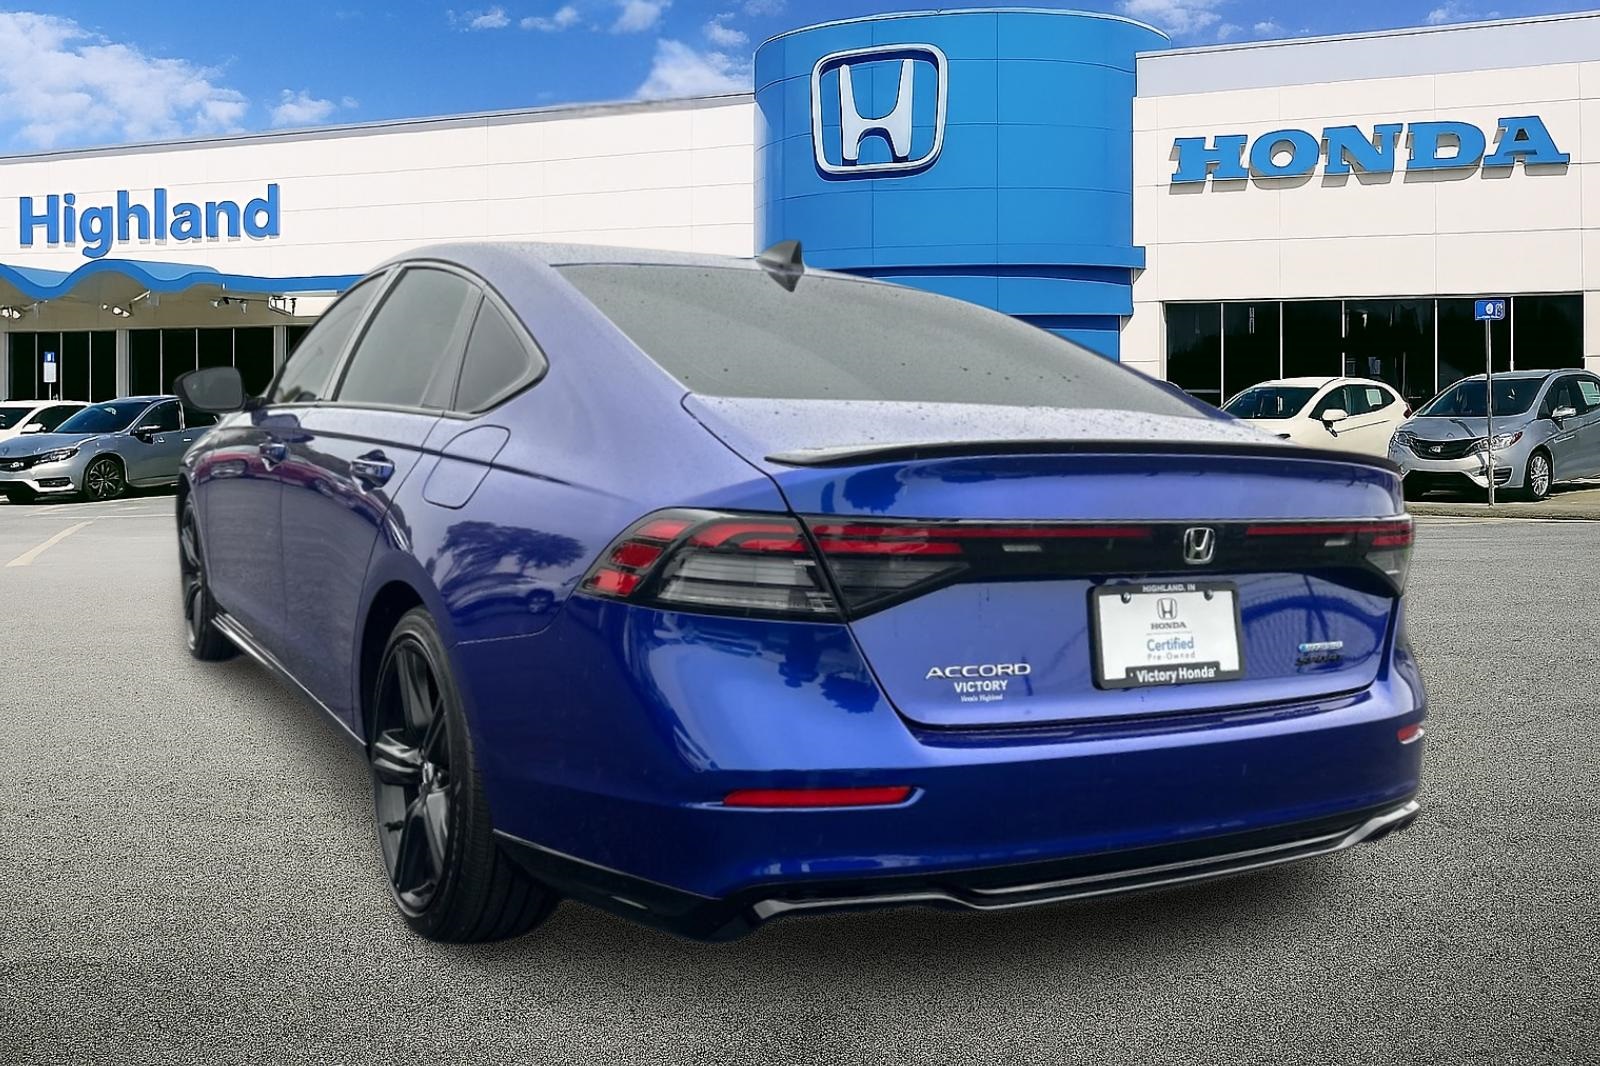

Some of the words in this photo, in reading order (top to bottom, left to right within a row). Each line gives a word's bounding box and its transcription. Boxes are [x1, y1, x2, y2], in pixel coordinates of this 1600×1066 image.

[1170, 115, 1571, 187] HONDA
[19, 183, 280, 258] Highland
[1187, 583, 1196, 591] IN
[1151, 621, 1187, 630] HONDA
[1146, 636, 1195, 651] Certified
[925, 663, 1032, 680] ACCORD
[1136, 669, 1177, 683] Victory
[1179, 667, 1215, 679] Honda
[954, 680, 1009, 693] VICTORY
